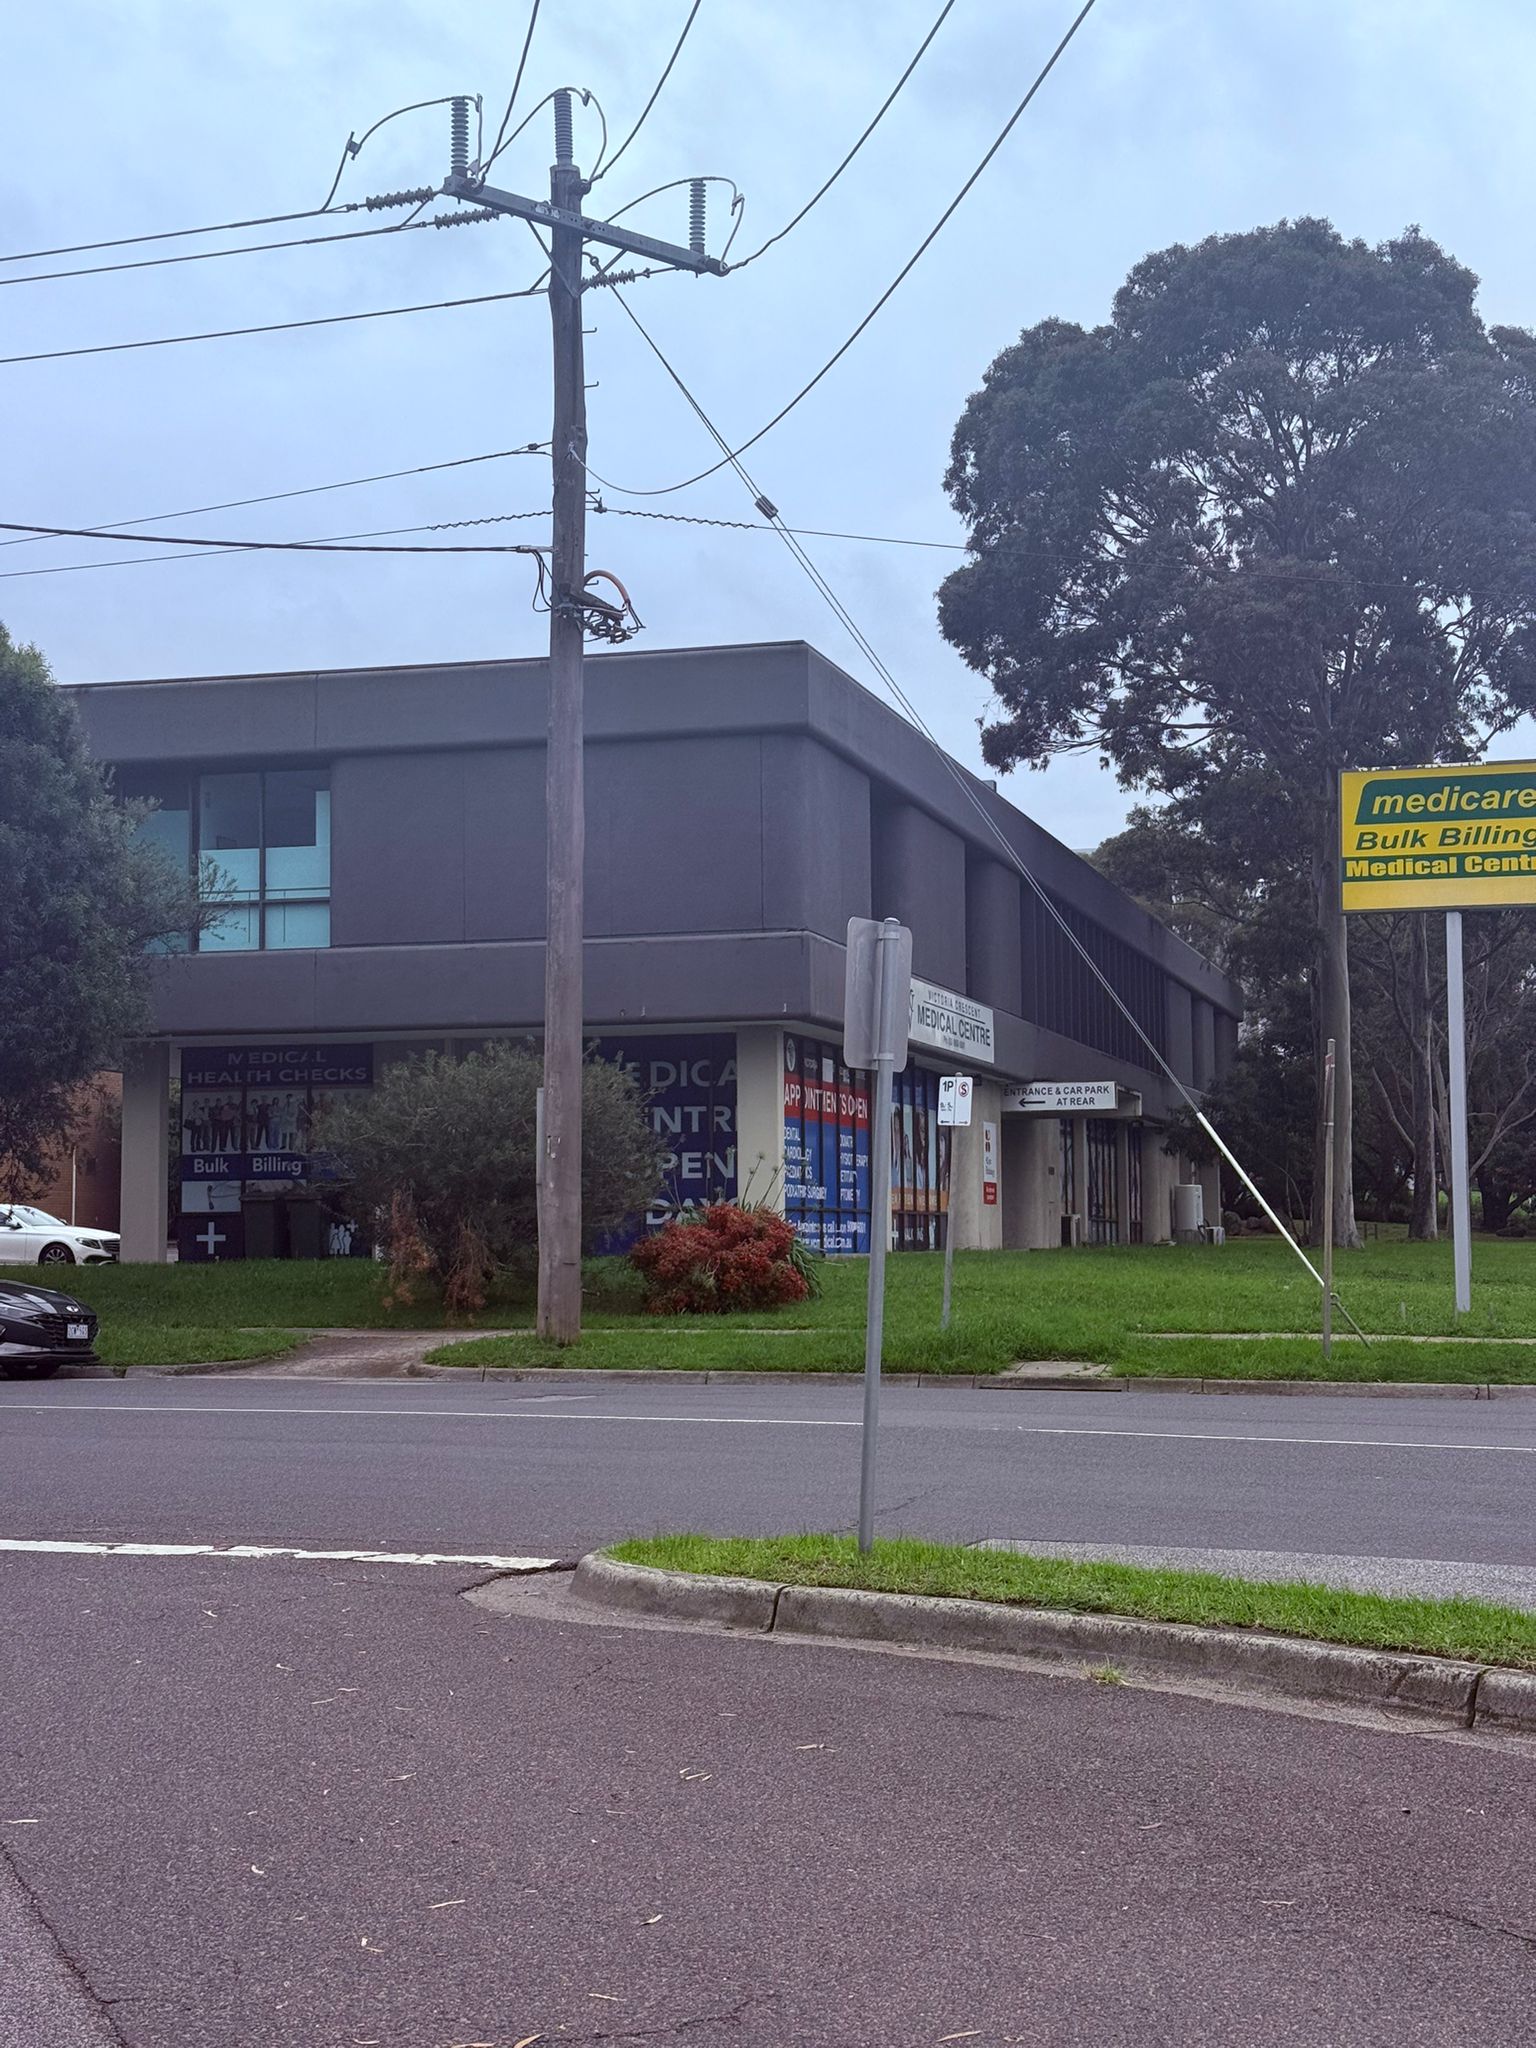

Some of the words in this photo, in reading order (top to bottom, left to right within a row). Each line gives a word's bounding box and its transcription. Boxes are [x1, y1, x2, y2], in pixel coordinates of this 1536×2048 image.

[1372, 785, 1536, 815] medicare
[1355, 829, 1429, 851] Bulk
[1438, 826, 1536, 848] Billing
[1345, 857, 1458, 877] Medical
[928, 990, 953, 1009] VICTORIA
[954, 999, 981, 1019] CRESCENT
[917, 1004, 957, 1036] MEDICAL
[958, 1018, 991, 1047] CENTRE
[187, 1069, 272, 1084] HEALTH
[278, 1067, 368, 1082] CHECKS
[941, 1080, 954, 1093] 1P
[1003, 1086, 1053, 1097] ENTRANCE
[1055, 1086, 1062, 1095] &
[1063, 1086, 1083, 1095] CAR
[1084, 1085, 1111, 1095] PARK
[847, 1094, 868, 1119] OEN
[1056, 1097, 1069, 1106] AT
[1070, 1096, 1096, 1106] REAR
[193, 1157, 229, 1174] Bulk
[252, 1156, 303, 1175] Billing
